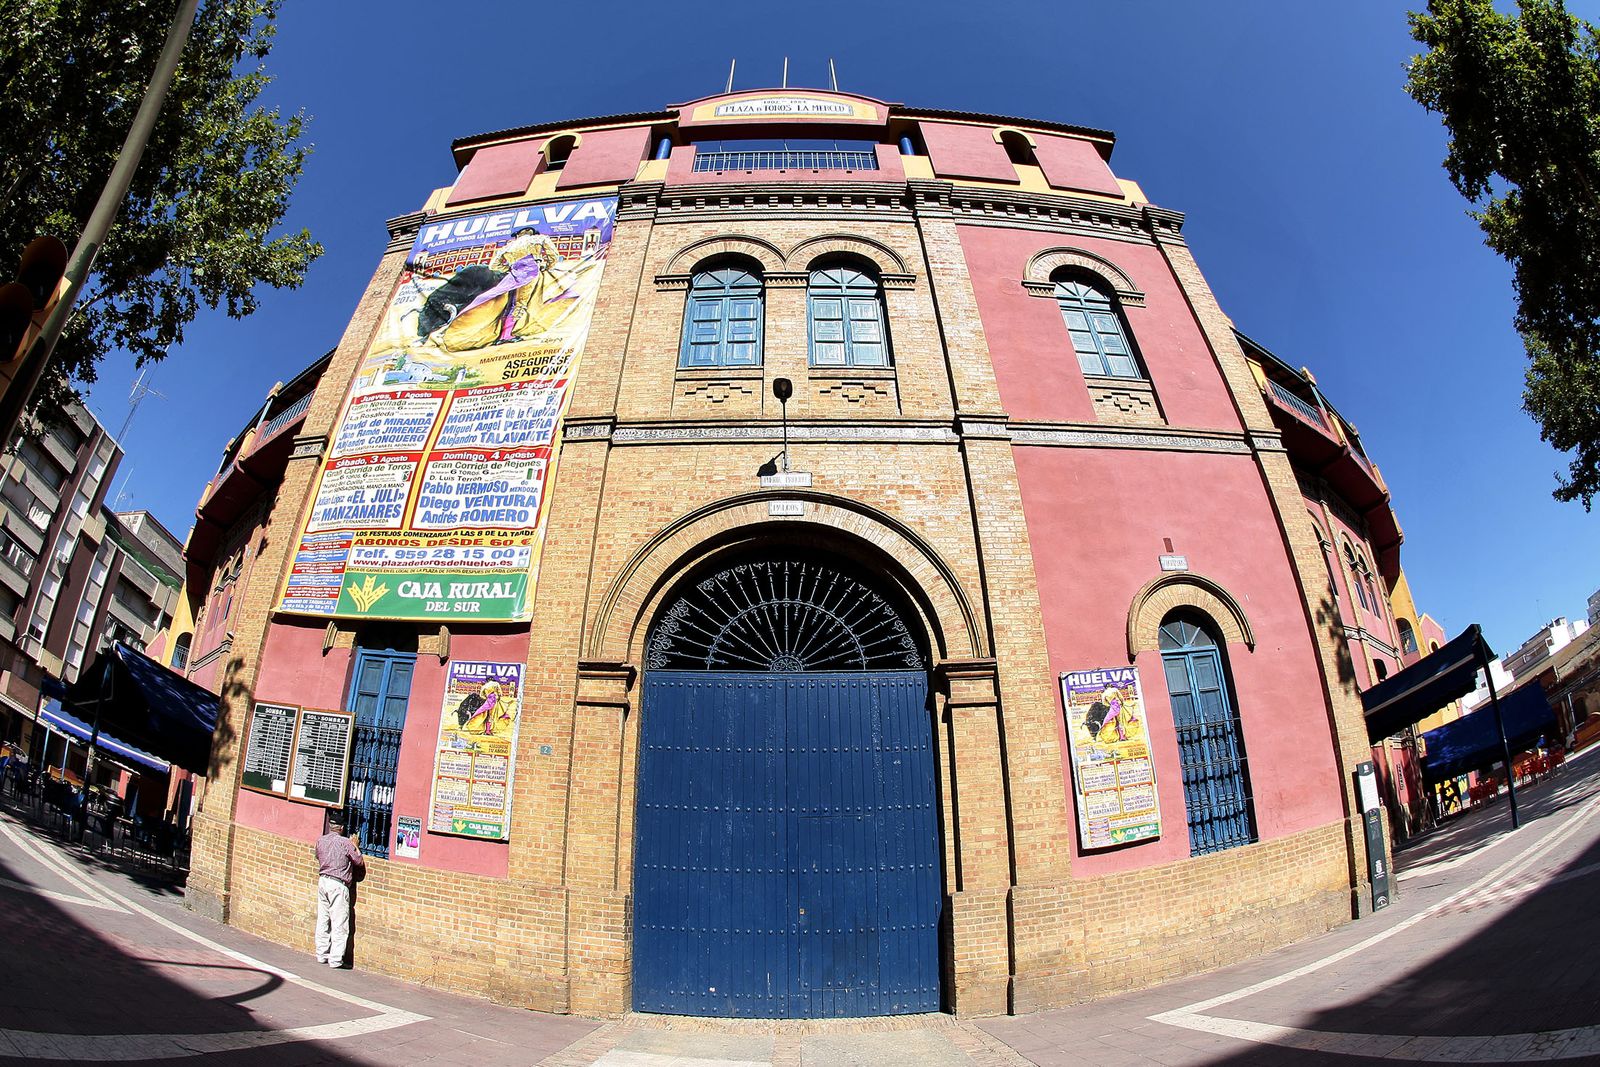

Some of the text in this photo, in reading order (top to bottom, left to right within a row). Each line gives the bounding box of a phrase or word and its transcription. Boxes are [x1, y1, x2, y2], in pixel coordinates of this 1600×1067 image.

[764, 104, 792, 112] TOROS
[797, 104, 809, 112] LA
[812, 104, 845, 112] MERCED
[421, 201, 608, 244] HUELVA
[456, 235, 476, 243] TOROS
[486, 230, 512, 238] MERCED
[479, 353, 527, 364] MANTENEMOS
[528, 350, 542, 358] LOS
[502, 370, 519, 380] SU
[468, 386, 506, 396] Viernes,
[360, 393, 392, 402] Jueves,
[404, 392, 432, 400] Agosto
[456, 396, 478, 404] Gran
[480, 391, 514, 402] Corrida
[369, 400, 407, 408] Novillada
[446, 408, 504, 424] MORANTE
[506, 407, 516, 418] de
[517, 408, 524, 418] la
[369, 419, 382, 428] de
[384, 418, 432, 426] MIRANDA
[442, 423, 472, 434] Miguel
[474, 420, 501, 432] Angel
[382, 426, 430, 434] JIMENEZ
[368, 434, 426, 444] CONQUERO
[438, 430, 550, 448] Alejandro TALAVANTE
[370, 456, 379, 464] 3
[442, 451, 536, 462] Domingo, 4 Agosto
[326, 463, 412, 478] Gran Corrida de Toros
[454, 461, 488, 470] Corrida
[504, 460, 542, 468] Rejones
[422, 482, 453, 494] Pablo
[455, 480, 510, 496] HERMOSO
[509, 486, 538, 494] MENDOZA
[346, 490, 366, 504] «EL
[370, 488, 405, 503] JULI»
[420, 495, 538, 512] Diego VENTURA
[321, 504, 402, 522] MANZANARES
[420, 508, 530, 524] Andrés ROMERO
[510, 530, 535, 538] TARDE
[354, 538, 422, 546] ABONOS
[426, 538, 484, 547] DESDE
[490, 538, 514, 546] 60
[520, 538, 532, 546] €
[355, 548, 389, 558] Telf.
[394, 549, 428, 560] 959
[431, 549, 455, 558] 28
[462, 549, 485, 558] 15
[490, 548, 515, 558] 00
[352, 558, 514, 568] www.plazadetorosdehuelva.es
[398, 580, 518, 599] CAJA RURAL
[424, 601, 481, 612] DEL SUR
[454, 663, 518, 677] HUELVA
[1068, 670, 1134, 686] HUELVA
[265, 708, 286, 716] SOMBRA
[321, 716, 346, 724] SOMBRA
